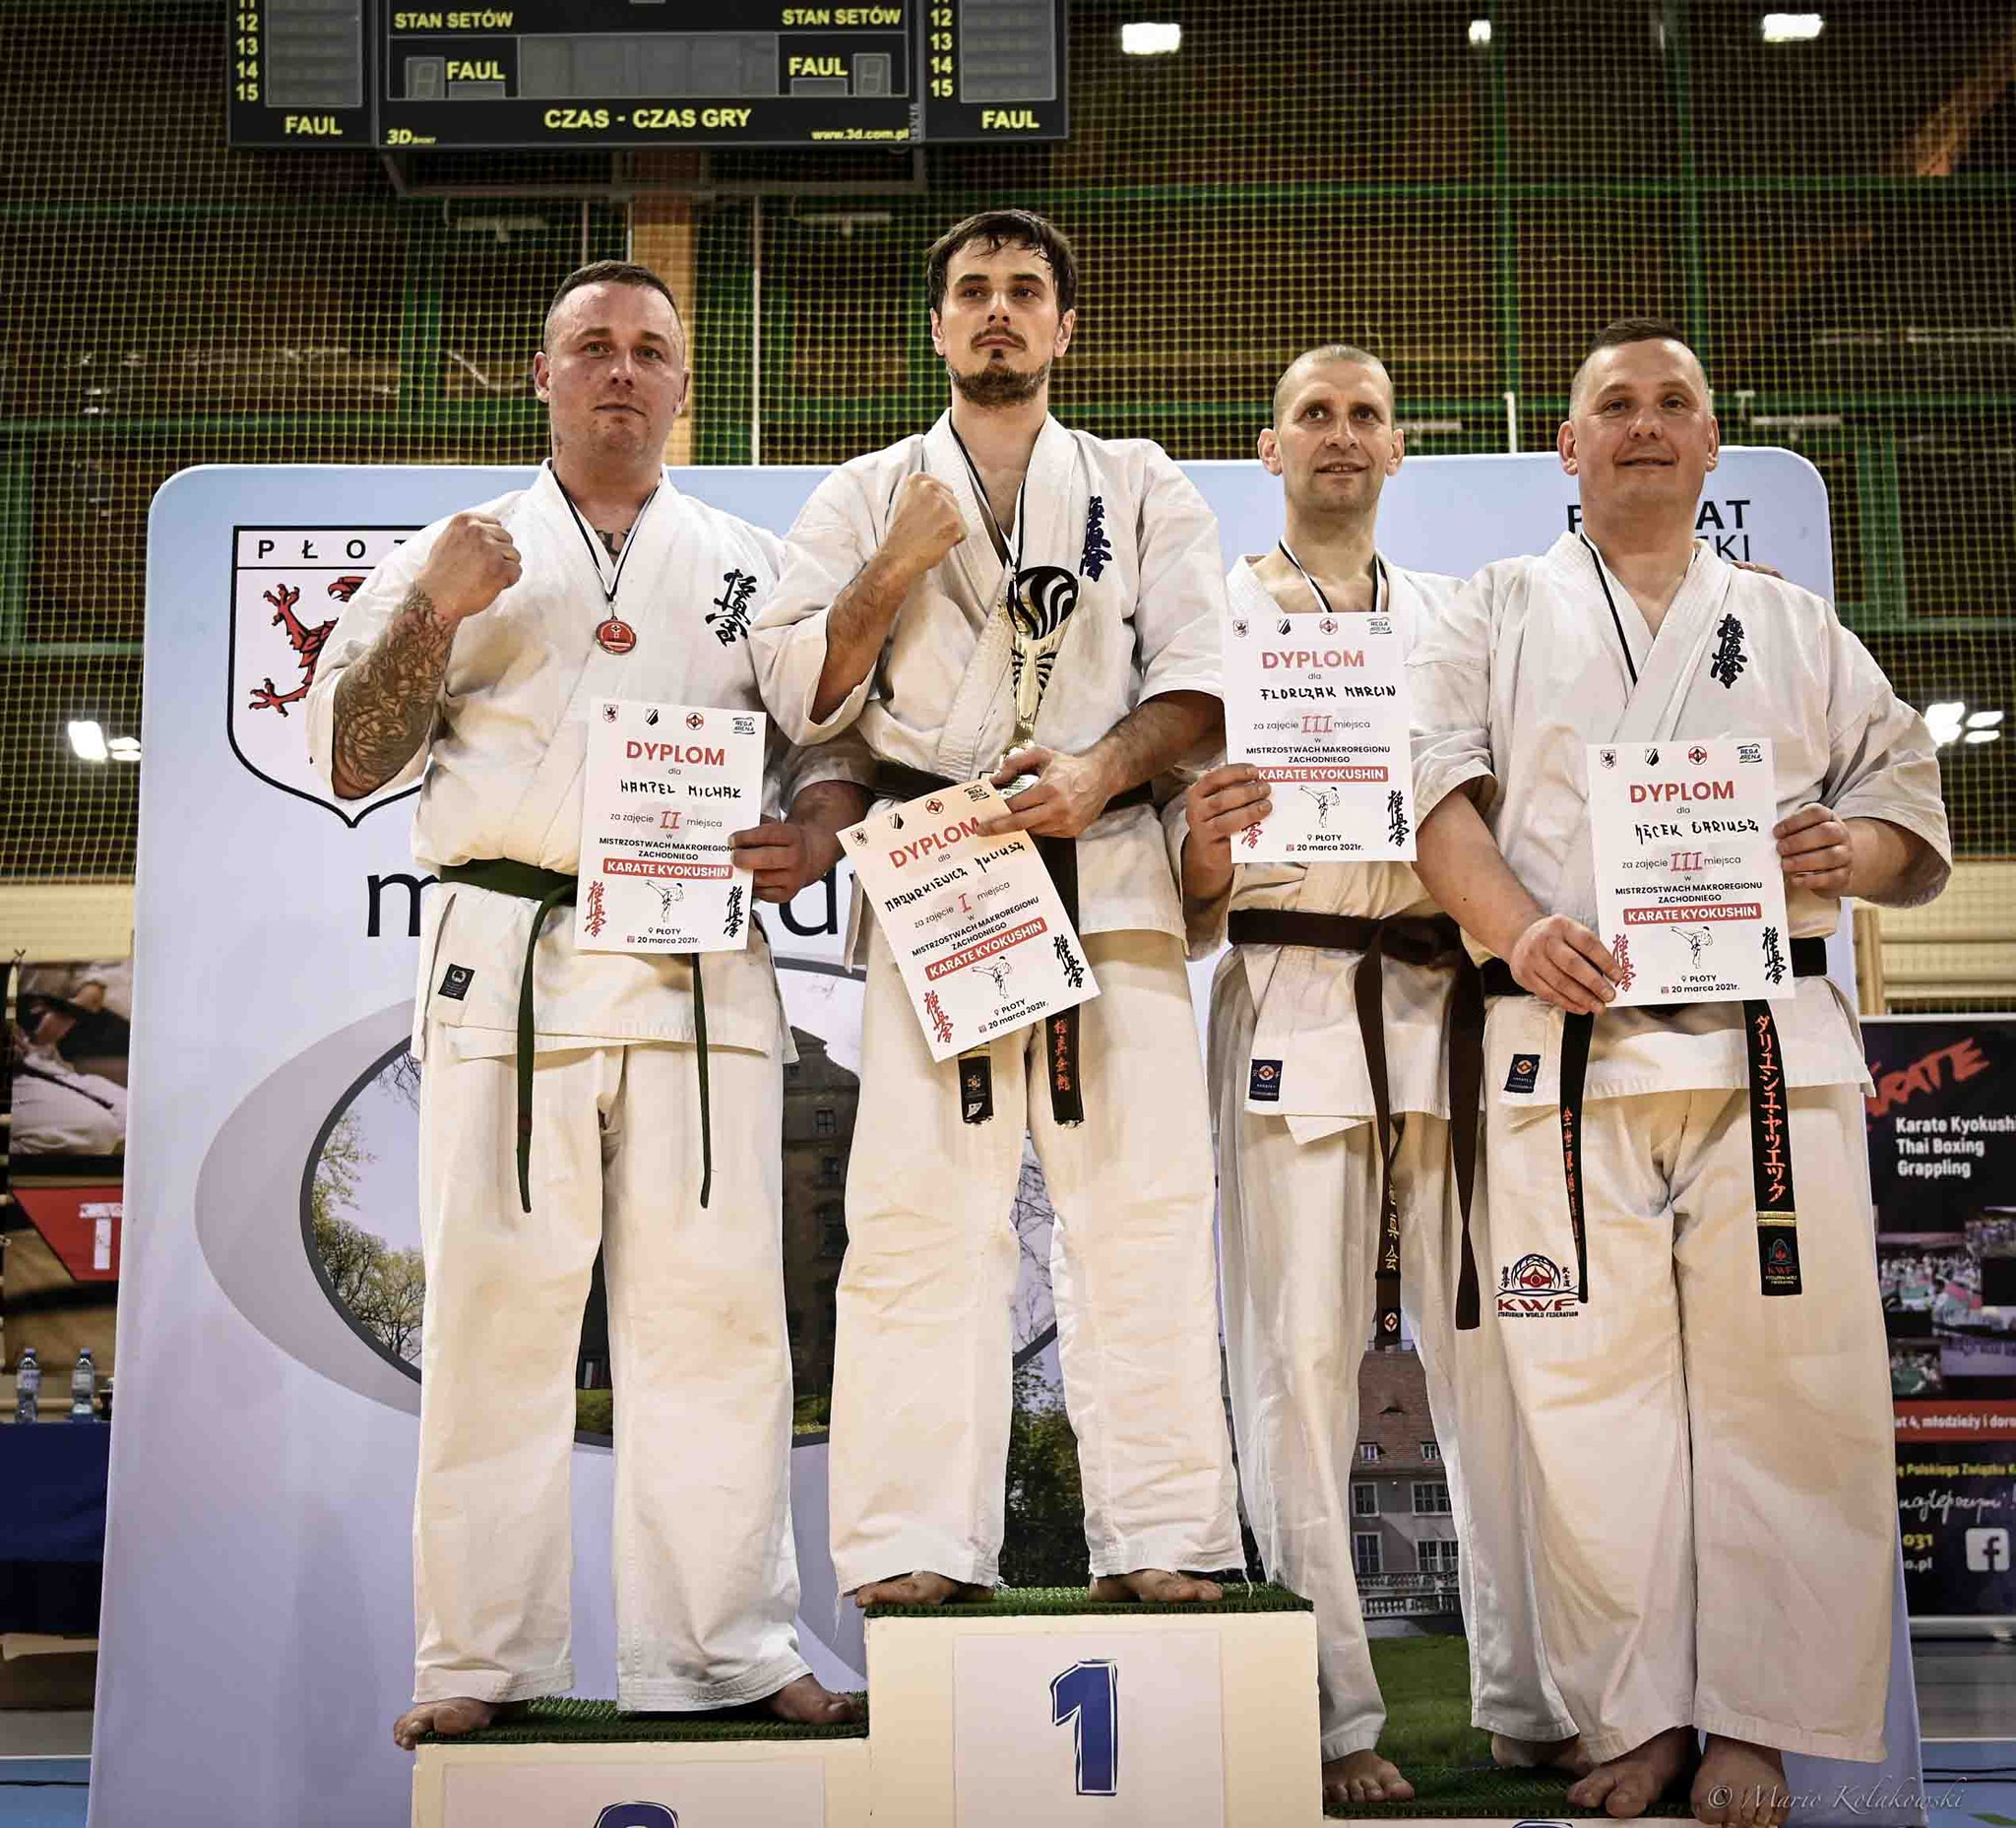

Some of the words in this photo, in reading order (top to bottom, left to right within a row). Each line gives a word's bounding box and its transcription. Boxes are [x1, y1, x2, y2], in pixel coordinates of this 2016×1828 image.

[236, 13, 259, 32] 12
[395, 13, 442, 29] STAN
[447, 10, 514, 29] SETÓW
[782, 9, 832, 26] STAN
[835, 7, 902, 26] SETÓW
[930, 9, 953, 27] 12
[236, 36, 259, 56] 13
[930, 32, 953, 51] 13
[236, 60, 259, 79] 14
[446, 61, 506, 80] FAUL
[788, 57, 848, 76] FAUL
[930, 56, 953, 74] 14
[236, 82, 259, 101] 15
[930, 80, 953, 97] 15
[285, 116, 343, 136] FAUL
[543, 109, 610, 129] CZAS
[632, 109, 696, 129] CZAS
[701, 108, 752, 128] GRY
[981, 110, 1040, 129] FAUL
[387, 129, 412, 145] 3D
[811, 128, 910, 142] www.3d.com.pl
[1567, 500, 1750, 534] PAT
[1262, 650, 1364, 669] DYPLOM
[1307, 671, 1322, 680] dla
[1267, 720, 1299, 731] zajęcie
[1334, 720, 1370, 731] miejsca
[626, 740, 725, 767] DYPLOM
[1246, 746, 1320, 755] MISTRZOSTWACH
[1322, 745, 1391, 754] MAKROREGIONU
[1289, 755, 1351, 764] ZACHODNIEGO
[667, 767, 681, 776] dla
[1258, 769, 1307, 781] KARATE
[1309, 769, 1384, 781] KYOKUSHIN
[1629, 781, 1734, 803] DYPLOM
[1676, 806, 1690, 815] dla
[623, 812, 654, 824] zajęcie
[686, 817, 723, 829] miejsca
[598, 837, 671, 850] MISTRZOSTWACH
[671, 843, 735, 853] MAKROREGION
[889, 816, 981, 868] DYPLOM
[638, 851, 699, 861] ZACHODNIEGO
[937, 852, 951, 863] dla
[1622, 860, 1633, 869] za
[1635, 858, 1668, 870] zajęcie
[1704, 855, 1741, 866] miejsca
[606, 861, 656, 876] KARATE
[657, 863, 729, 877] KYOKUSHIN
[1615, 884, 1690, 896] MISTRZOSTWACH
[1692, 881, 1762, 893] MAKROREGIONU
[914, 919, 924, 928] za
[926, 906, 955, 924] zajęcie
[976, 881, 1011, 902] miejsca
[1658, 894, 1722, 905] ZACHODNIEGO
[1628, 908, 1678, 922] KARATE
[1680, 906, 1757, 921] KYOKUSHIN
[912, 923, 978, 958] MISTRZOSTWACH
[977, 896, 1040, 928] MAKROREGIONU
[951, 921, 1007, 951] ZACHODNIEGO
[677, 936, 700, 945] 2021r.
[929, 951, 976, 977] KARATE
[975, 919, 1043, 958] KYOKUSHIN
[1689, 974, 1717, 982] PŁOTY
[1683, 984, 1714, 993] marca
[1715, 982, 1740, 991] 2021r.
[1001, 998, 1026, 1014] PŁOTY
[988, 1020, 999, 1030] 20
[999, 1010, 1026, 1025] marca
[1027, 1001, 1049, 1016] 2021r.
[1896, 1116, 1948, 1133] Karate
[1896, 1138, 1929, 1155] Thai
[1932, 1137, 1984, 1158] Boxing
[1897, 1159, 1971, 1179] Grappling
[1498, 1298, 1578, 1311] KWF
[1050, 1659, 1118, 1797] 1
